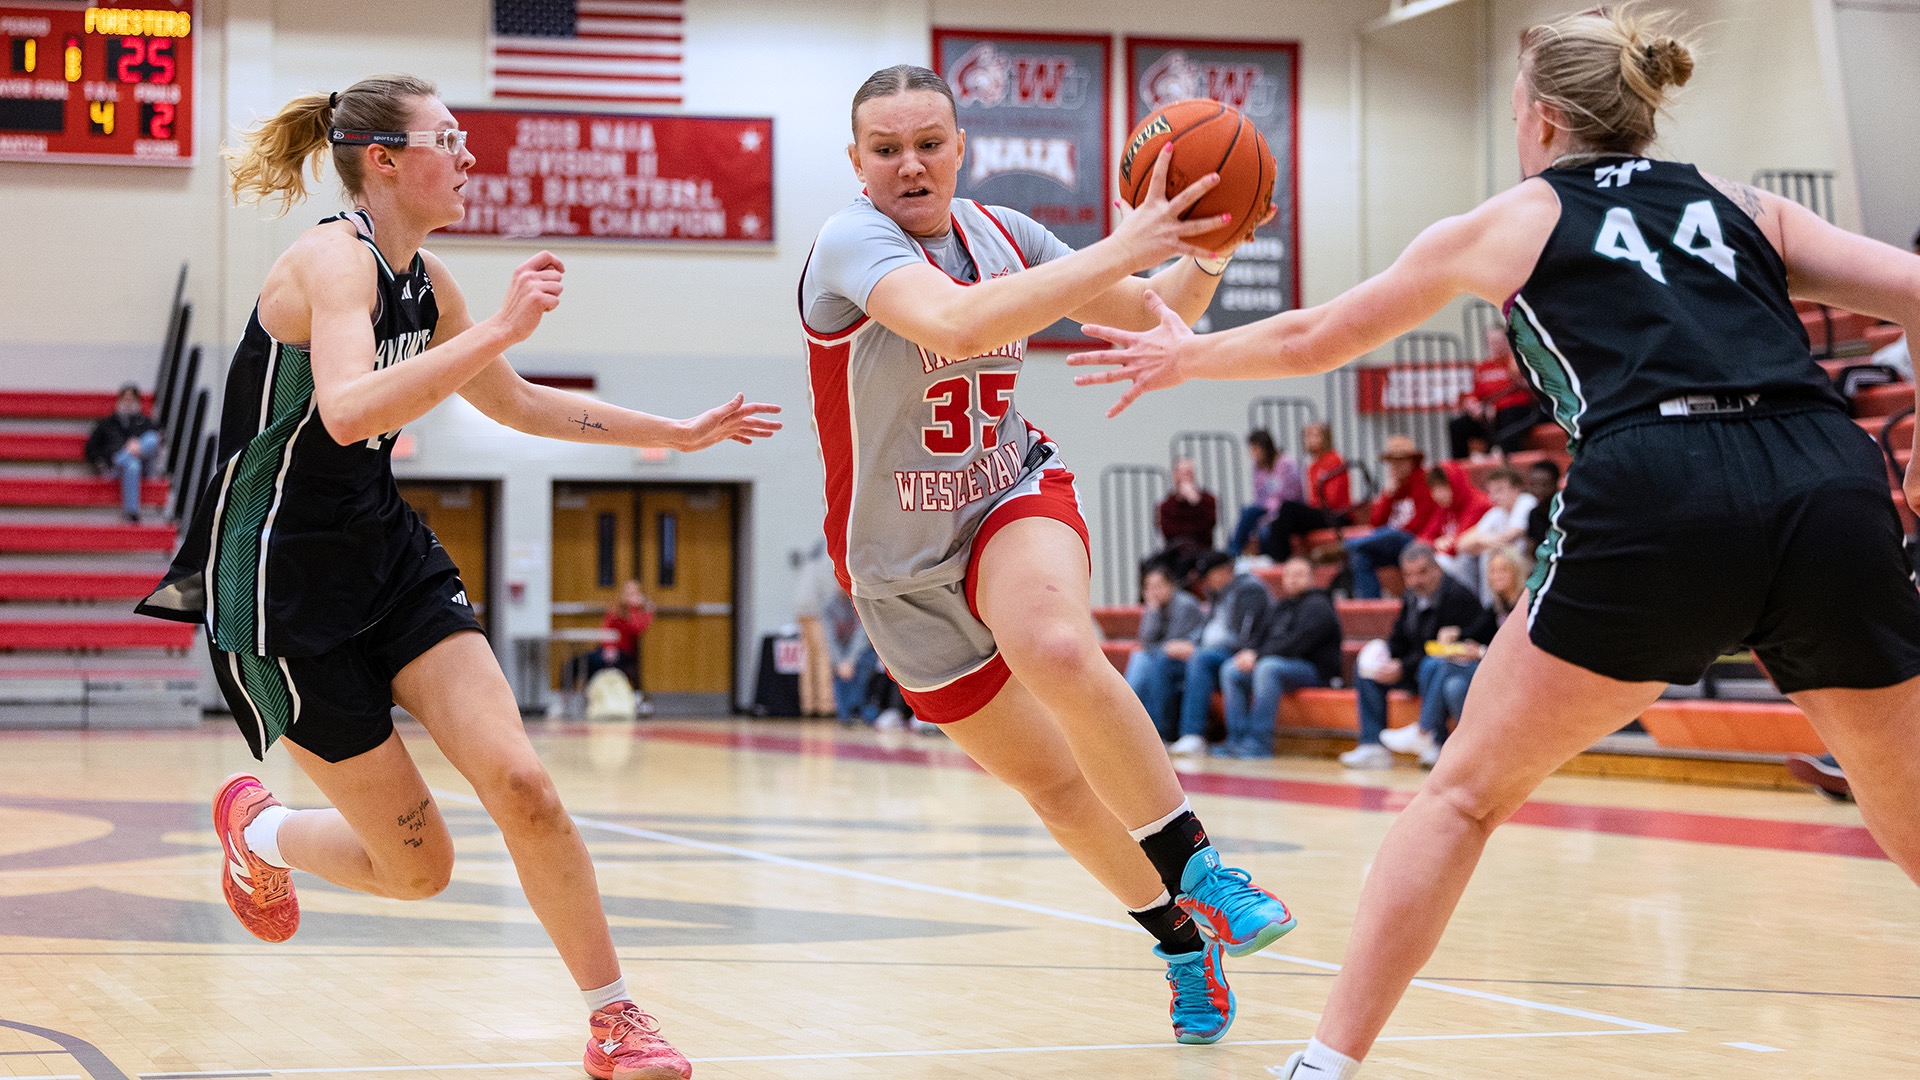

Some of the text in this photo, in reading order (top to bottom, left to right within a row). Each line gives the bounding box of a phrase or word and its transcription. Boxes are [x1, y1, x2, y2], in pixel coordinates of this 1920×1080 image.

[85, 8, 191, 37] FORESTERS
[118, 36, 175, 84] 25
[90, 101, 114, 134] 4
[151, 102, 174, 138] 2
[591, 121, 656, 150] NAIA
[508, 150, 625, 177] DIVISION
[972, 136, 1077, 192] NAIA
[543, 176, 723, 209] BASKETBALL
[590, 206, 726, 237] CHAMPION
[1594, 199, 1738, 285] 44
[921, 370, 1019, 456] 35
[894, 440, 1023, 511] WESLEYAN
